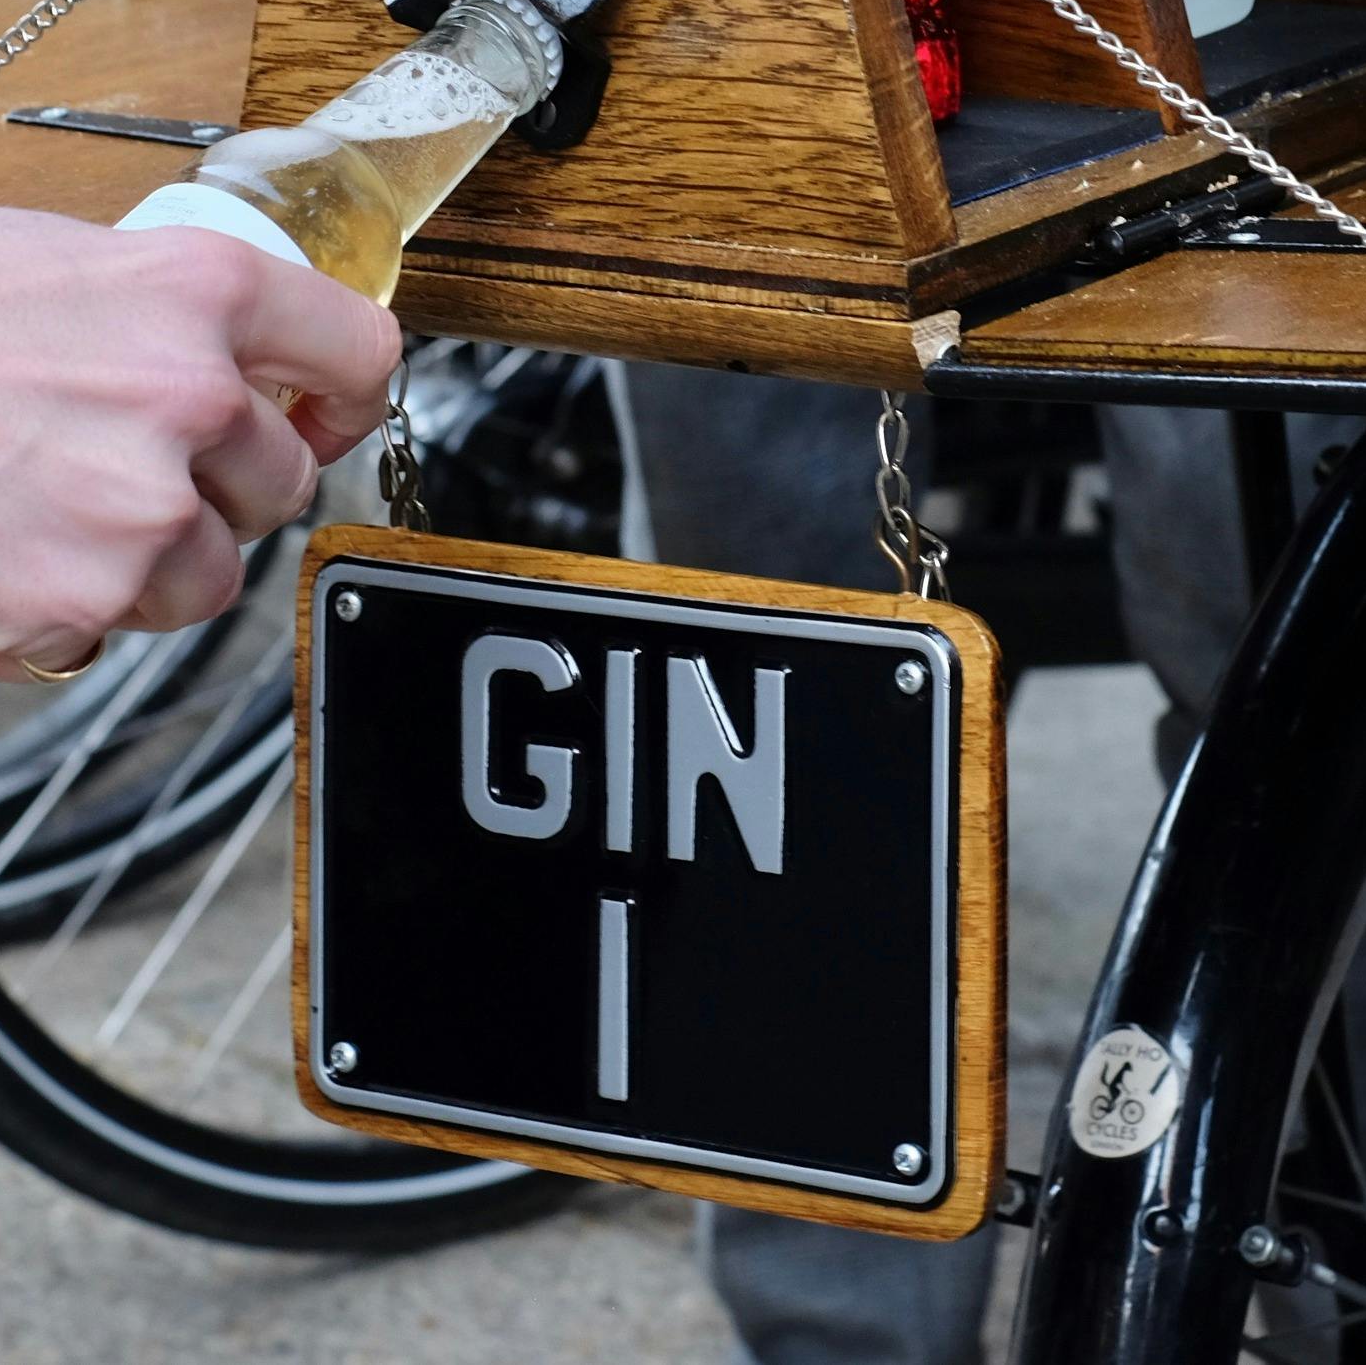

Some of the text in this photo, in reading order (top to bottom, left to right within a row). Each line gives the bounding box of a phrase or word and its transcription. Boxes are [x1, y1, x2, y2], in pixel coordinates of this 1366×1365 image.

[462, 634, 787, 875] GIN
[1136, 1045, 1162, 1061] HO
[1087, 1122, 1137, 1141] CYCLES
